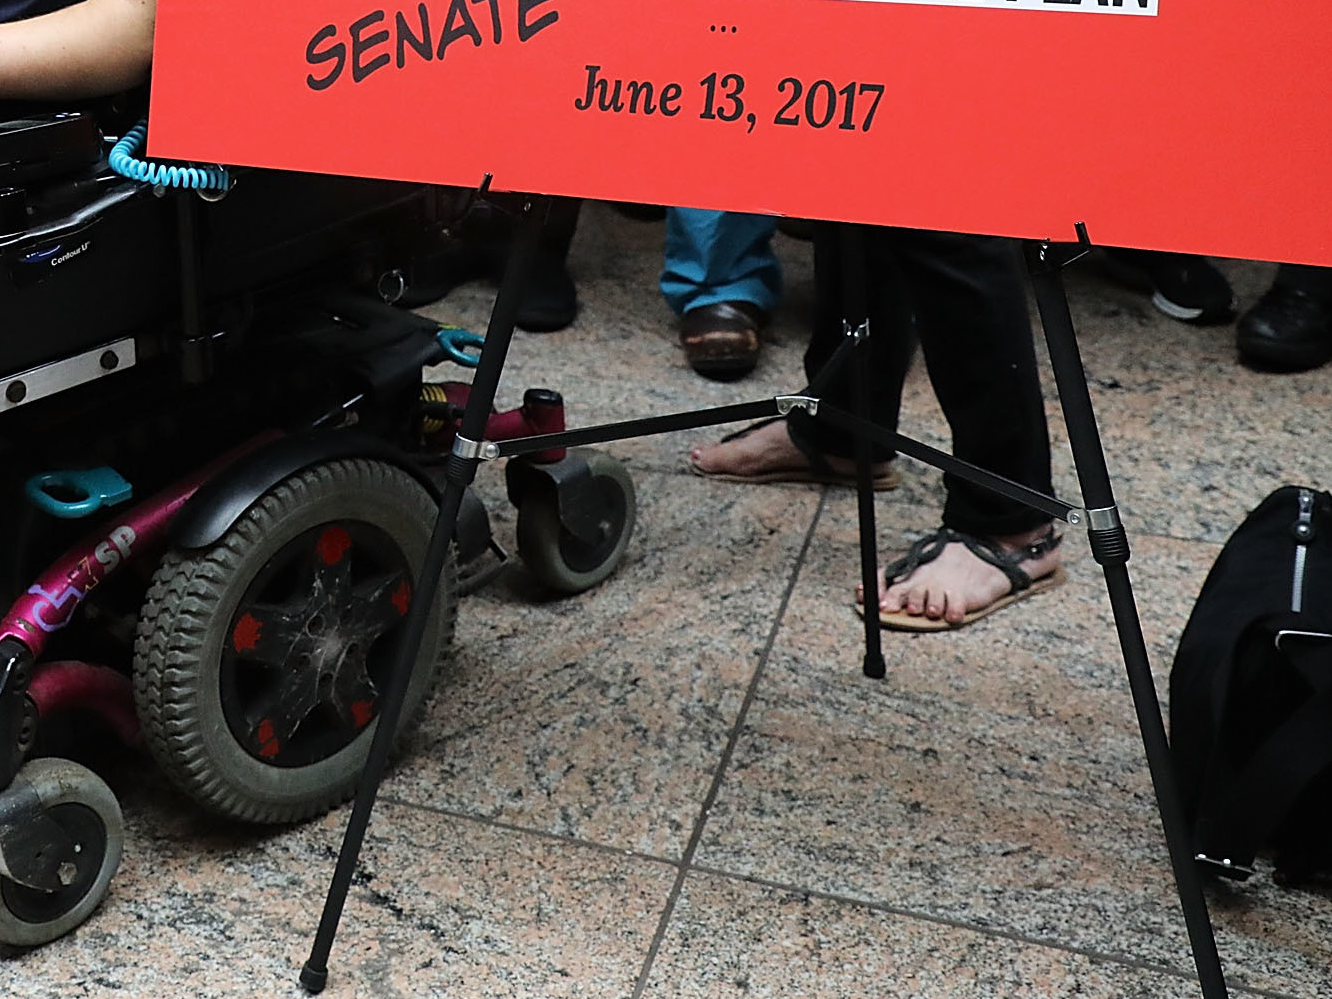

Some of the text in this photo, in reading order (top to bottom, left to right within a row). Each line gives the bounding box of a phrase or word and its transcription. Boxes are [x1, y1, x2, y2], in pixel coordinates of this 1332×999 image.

[574, 65, 885, 133] June 13, 2017
